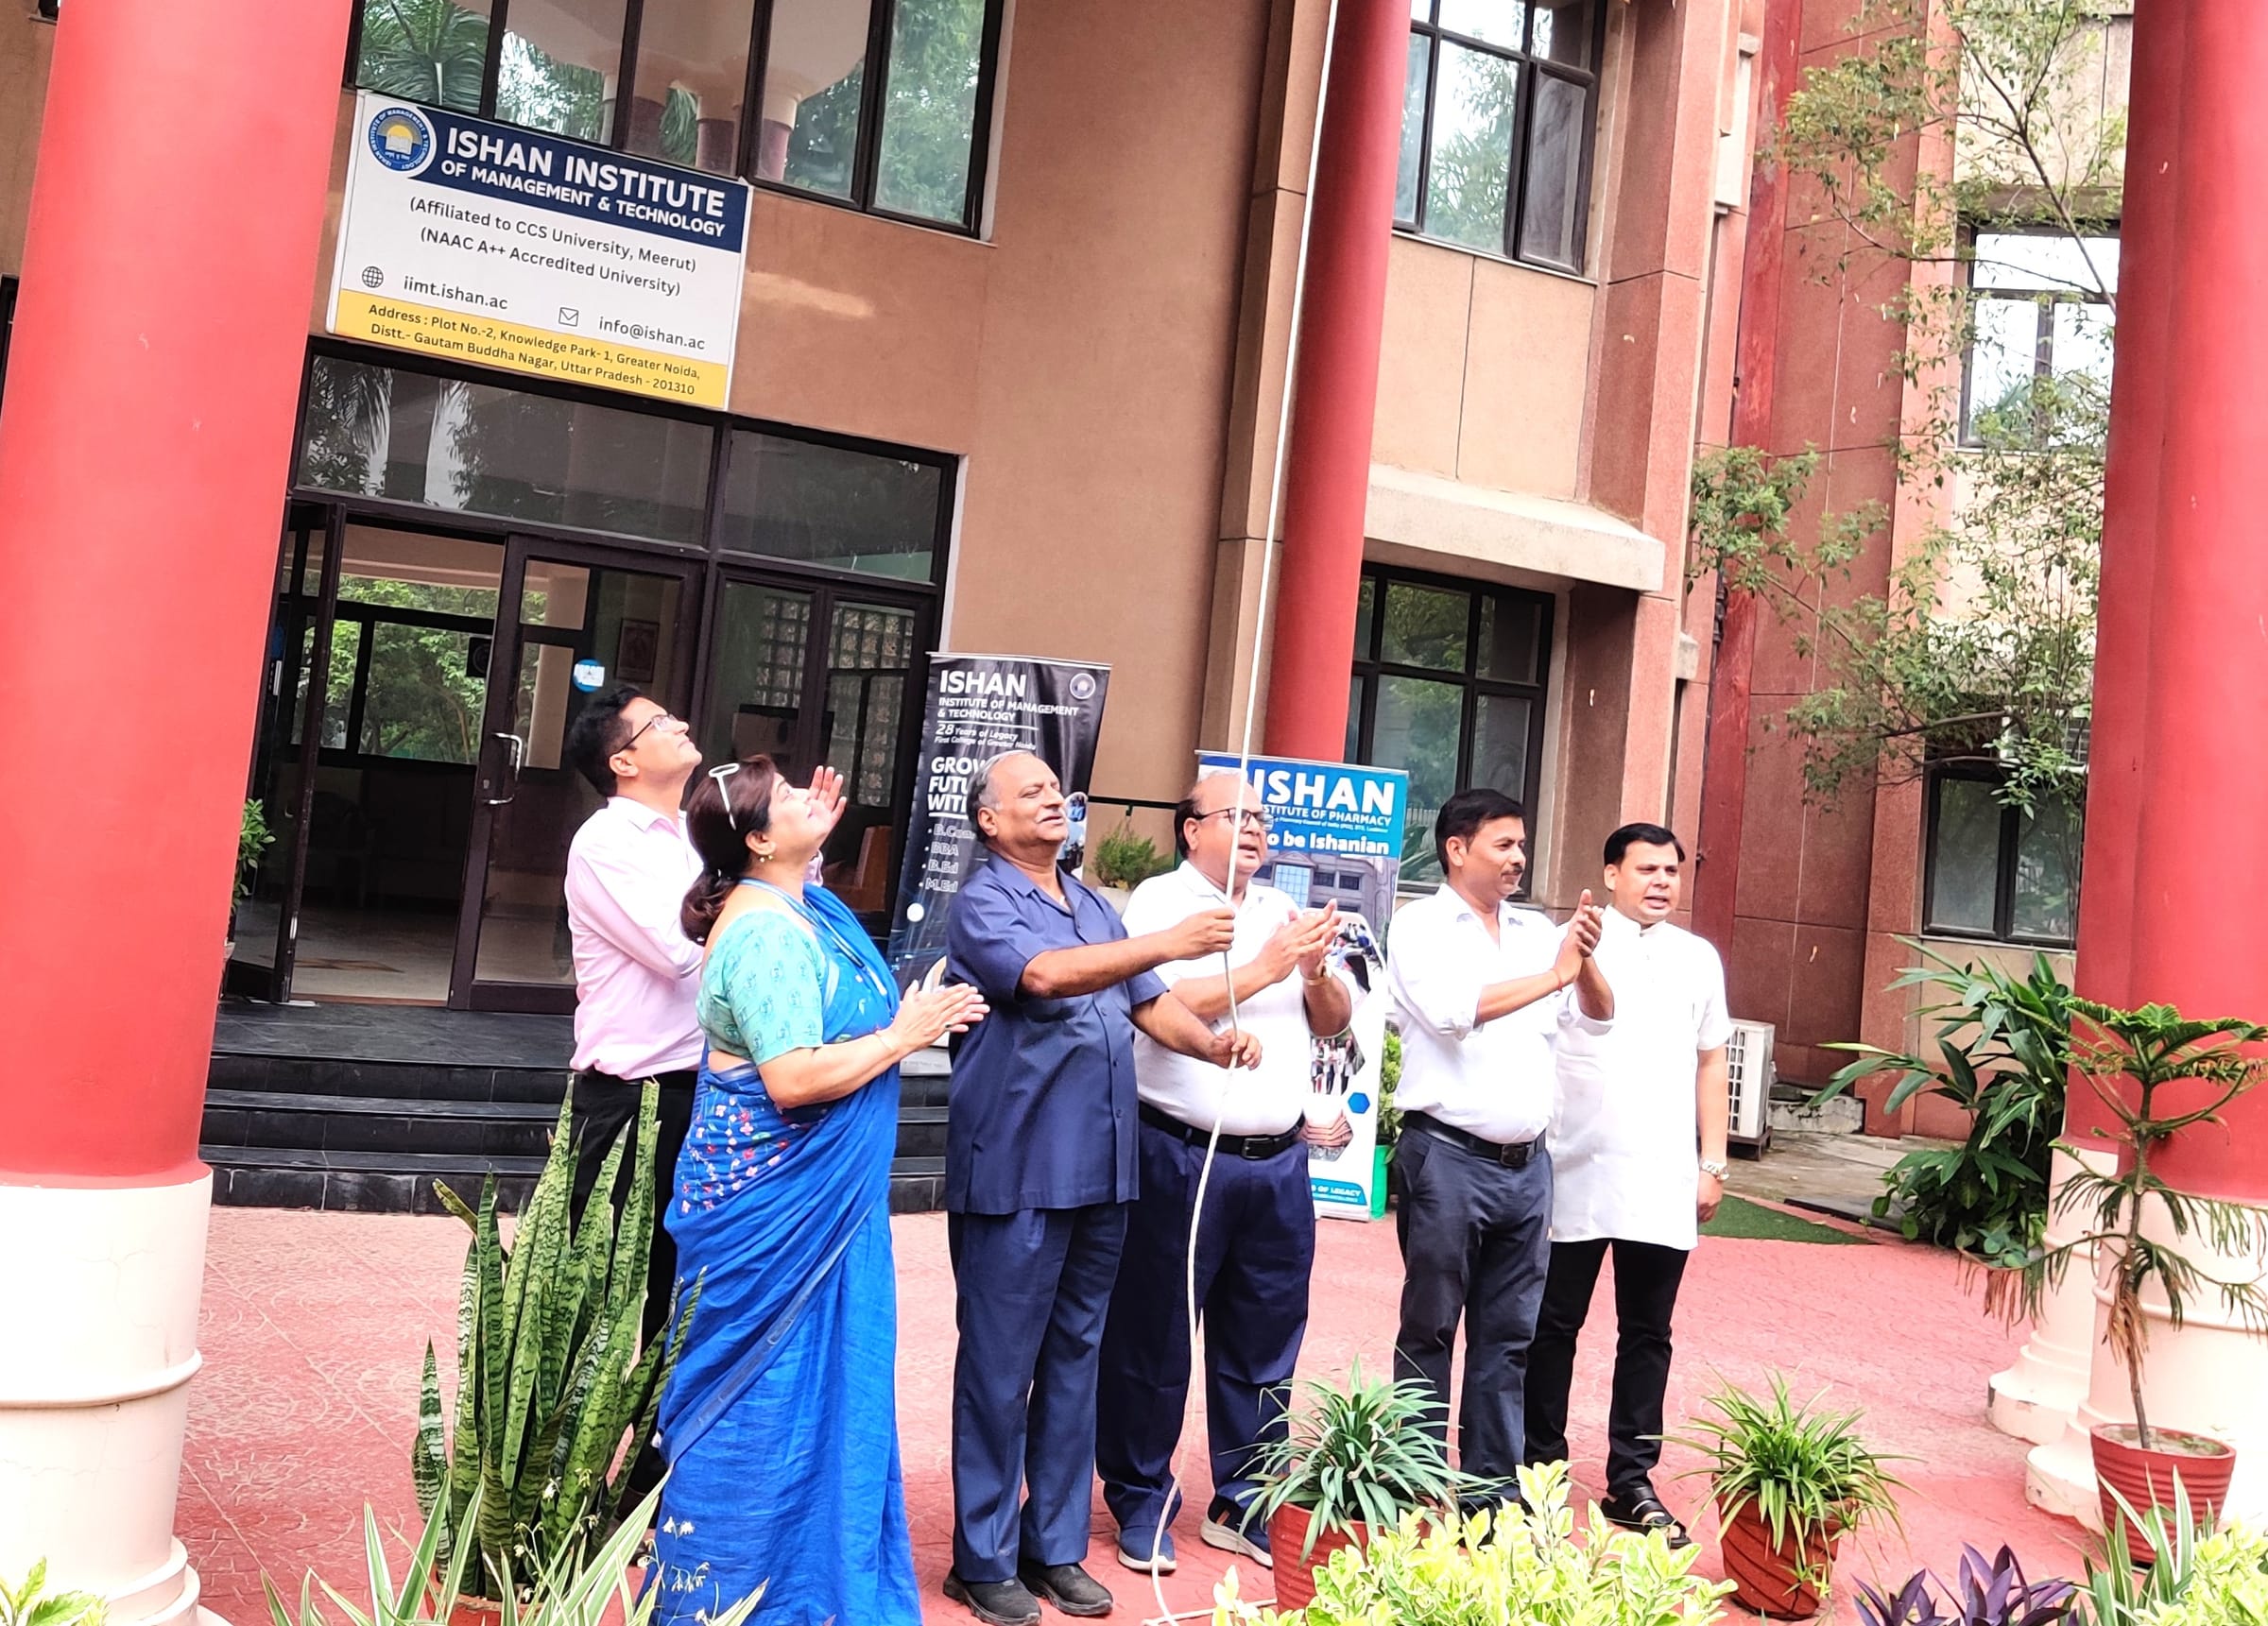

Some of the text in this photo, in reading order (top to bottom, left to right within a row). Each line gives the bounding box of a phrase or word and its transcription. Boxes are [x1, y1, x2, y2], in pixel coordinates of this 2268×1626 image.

[447, 127, 726, 217] ISHAN INSTITUTE
[440, 160, 726, 237] OF MANAGEMENT & TECHNOLOGY
[410, 197, 696, 273] (Affiliated to CCS University, Meerut)
[421, 227, 680, 297] (NAAC A++ Accredited University)
[404, 276, 508, 310] iimt.ishan.ac
[369, 304, 421, 324] Address
[431, 317, 457, 331] Plot
[460, 322, 496, 340] No.-2,
[500, 331, 567, 353] Knowledge
[570, 344, 601, 358] Park-
[616, 353, 662, 370] Greater
[663, 363, 700, 380] Noida,
[599, 317, 705, 350] info@ishan.ac
[371, 323, 410, 340] Distt.-
[414, 333, 463, 351] Gautam
[467, 343, 514, 361] Buddha
[518, 352, 558, 371] Nagar,
[560, 360, 593, 375] Uttar
[594, 368, 643, 385] Pradesh
[653, 379, 695, 394] 201310
[939, 670, 1027, 697] ISHAN
[936, 709, 1016, 721] & TECHNOLOGY
[938, 697, 1079, 716] INSTITUTE OF MANAGEMENT
[936, 724, 1019, 741] 28 Years of Legacy
[1253, 768, 1395, 815] ISHAN
[1263, 804, 1392, 827] STITUTE OF PHARMACY
[930, 841, 959, 856] BBA
[1266, 830, 1389, 854] o be Ishanian
[927, 859, 959, 874] B.Ed
[925, 877, 959, 893] M.Ed
